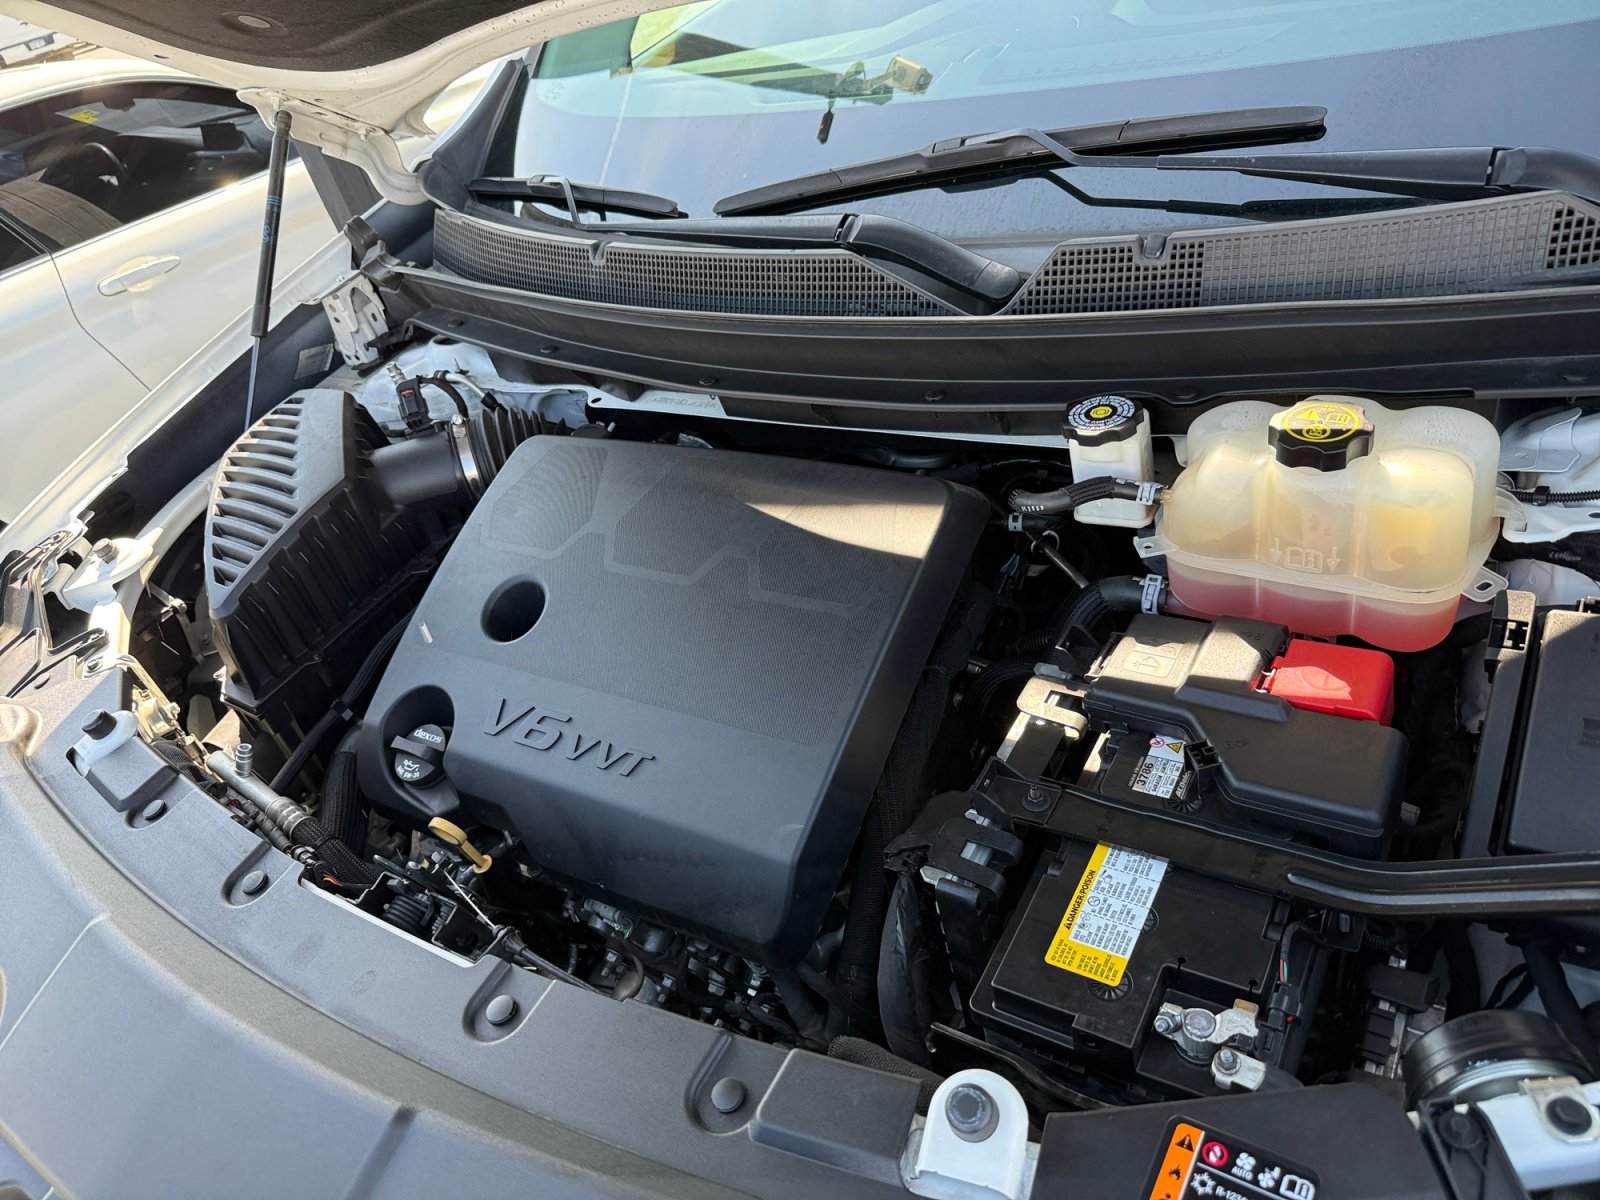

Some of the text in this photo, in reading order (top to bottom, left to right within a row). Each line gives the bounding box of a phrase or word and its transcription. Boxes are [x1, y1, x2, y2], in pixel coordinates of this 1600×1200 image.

[413, 728, 443, 744] dexos
[483, 694, 657, 777] V6 VVT
[1136, 762, 1154, 786] 3786
[1231, 1165, 1254, 1181] AUTO
